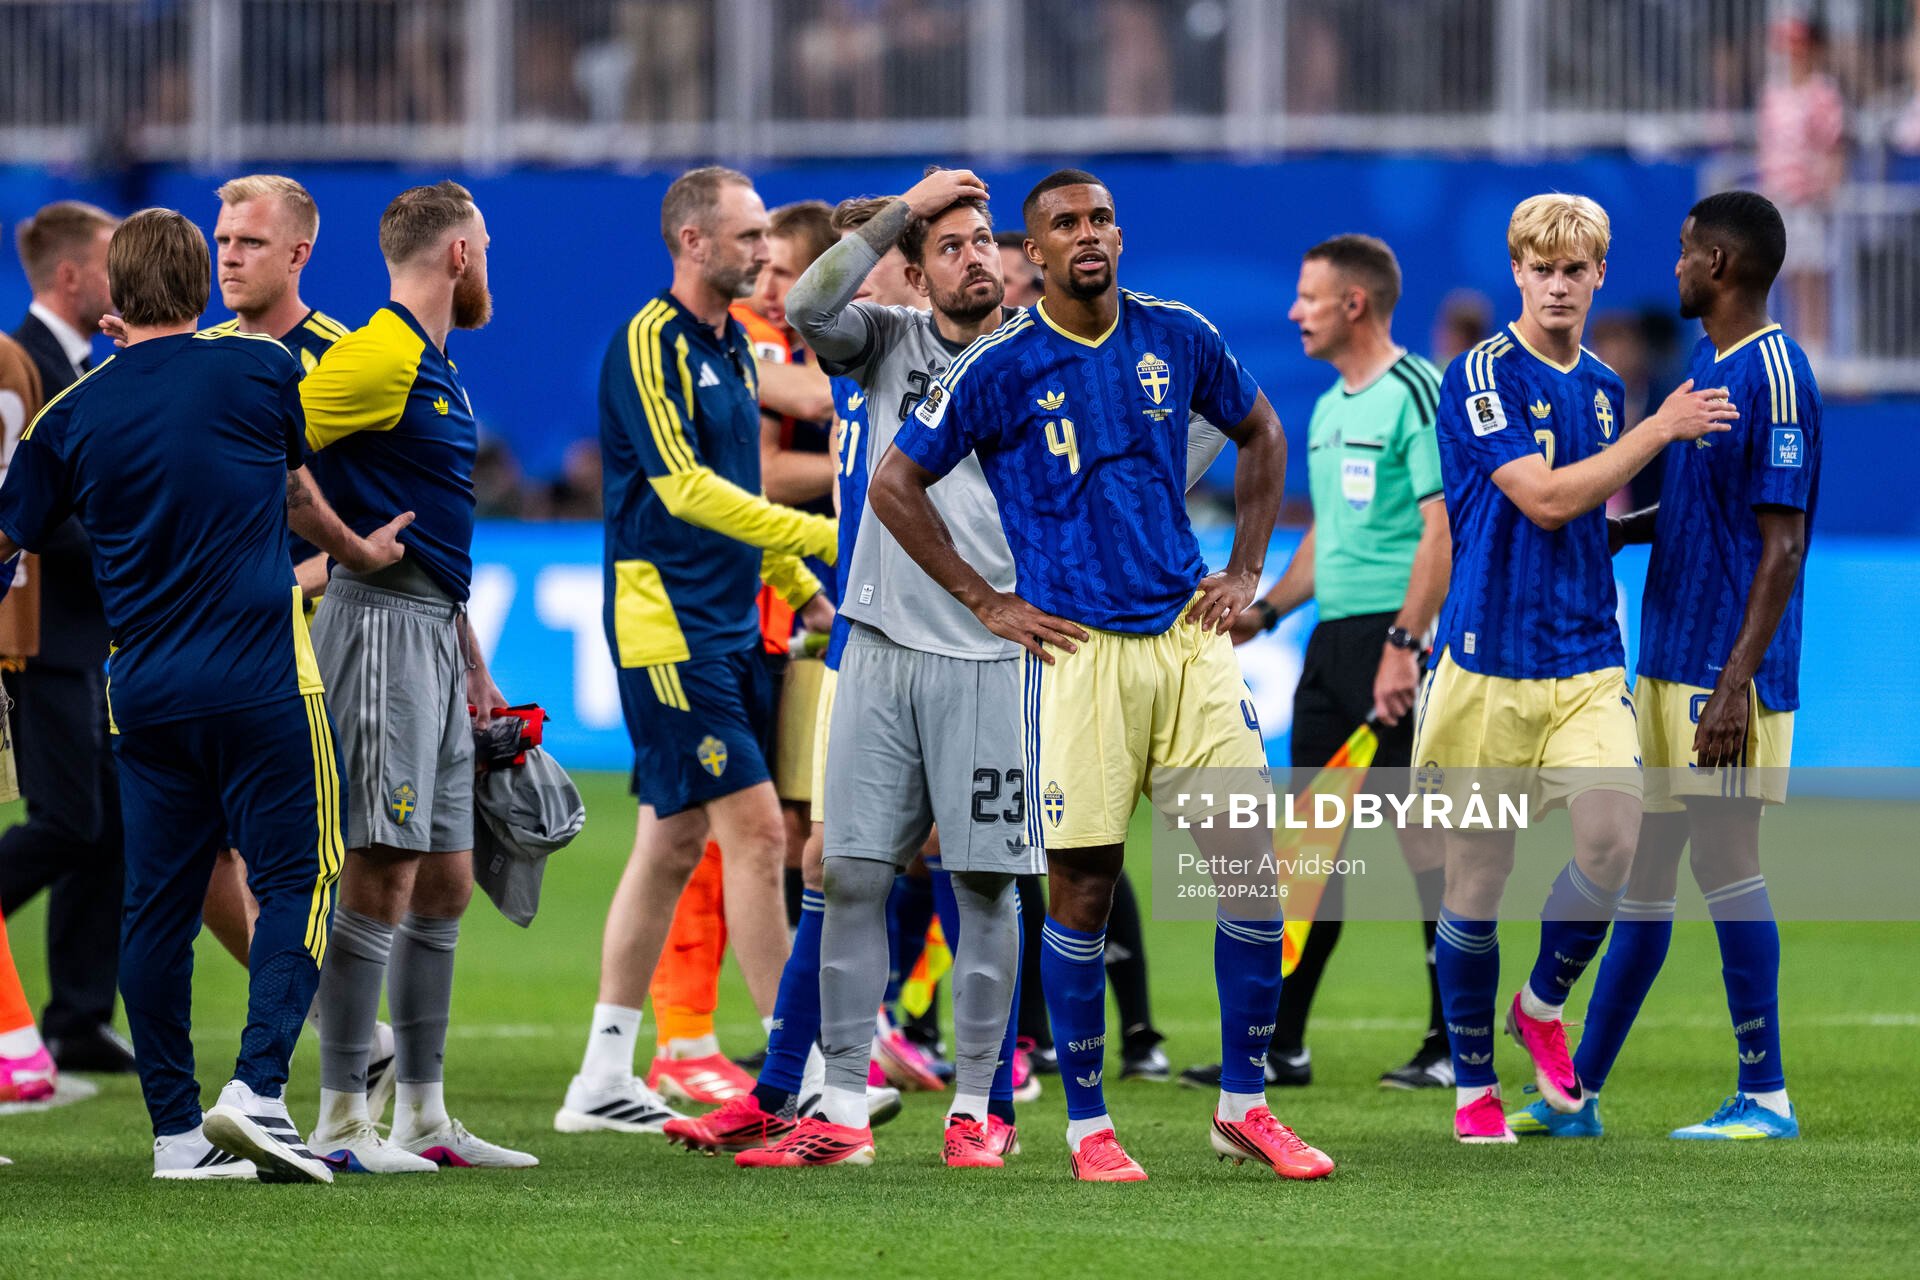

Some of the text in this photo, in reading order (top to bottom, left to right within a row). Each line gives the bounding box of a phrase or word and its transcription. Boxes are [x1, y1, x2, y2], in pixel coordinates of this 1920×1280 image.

[898, 370, 931, 421] 2
[1044, 418, 1081, 475] 4
[972, 767, 1025, 823] 23
